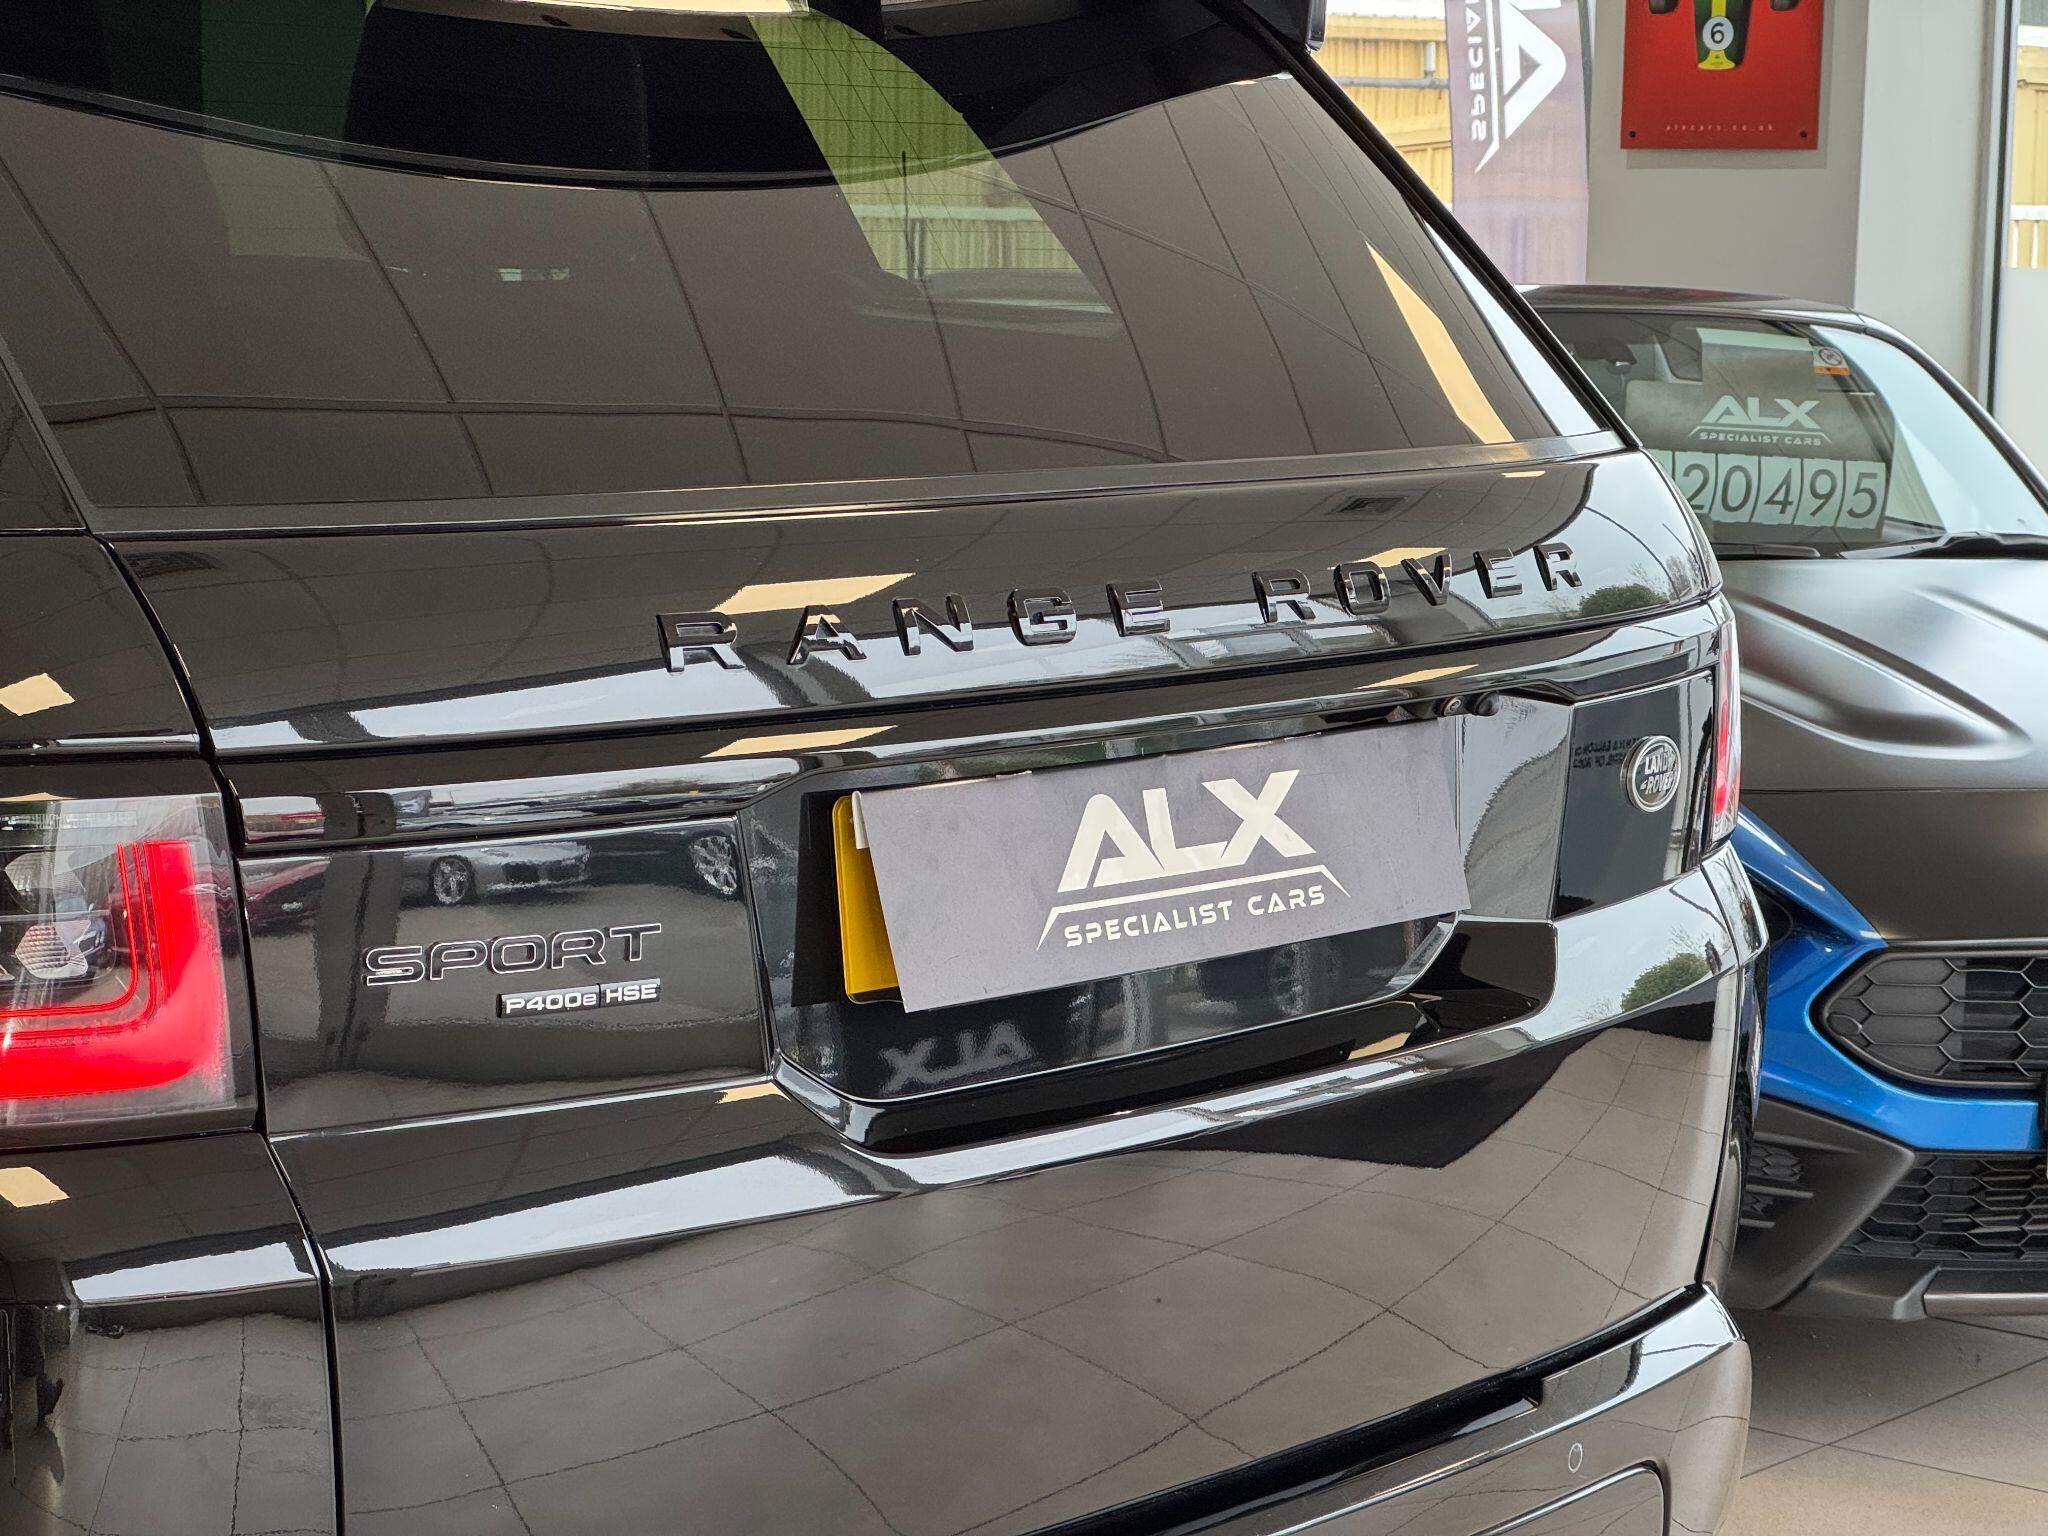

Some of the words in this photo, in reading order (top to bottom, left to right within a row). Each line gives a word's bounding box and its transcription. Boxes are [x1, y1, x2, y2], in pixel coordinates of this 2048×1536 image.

[1711, 22, 1725, 44] 6
[1701, 395, 1821, 430] ALX
[1699, 431, 1779, 444] SPECIALIST
[1784, 435, 1823, 446] CARS
[1682, 463, 1878, 519] 20495
[656, 578, 1171, 673] RANGE
[1252, 542, 1583, 623] ROVER
[1645, 751, 1669, 775] LAND
[1645, 772, 1674, 795] ROVER
[1057, 769, 1317, 893] ALX
[1064, 900, 1233, 948] SPECIALIST
[1247, 885, 1326, 917] CARS
[363, 923, 662, 987] SPORT
[505, 992, 597, 1014] P400e
[605, 983, 658, 1003] HSE
